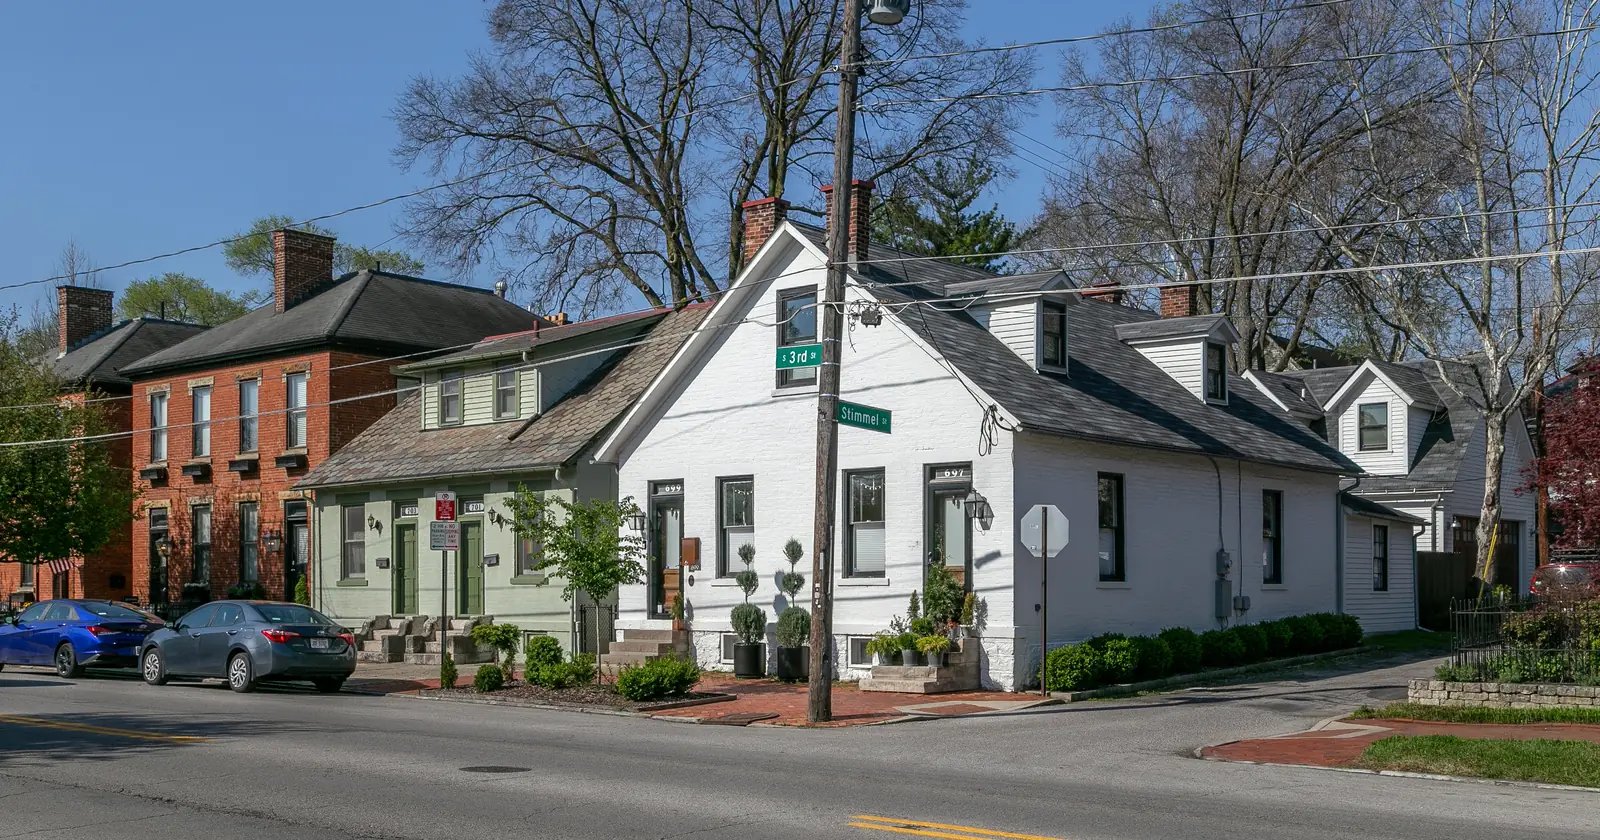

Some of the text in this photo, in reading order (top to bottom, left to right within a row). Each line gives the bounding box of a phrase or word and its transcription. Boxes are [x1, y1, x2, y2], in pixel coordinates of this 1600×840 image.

[782, 350, 816, 364] S 3rd St
[841, 406, 879, 426] Stimmel
[944, 468, 964, 477] 697
[665, 484, 681, 493] 699
[471, 503, 481, 511] 701
